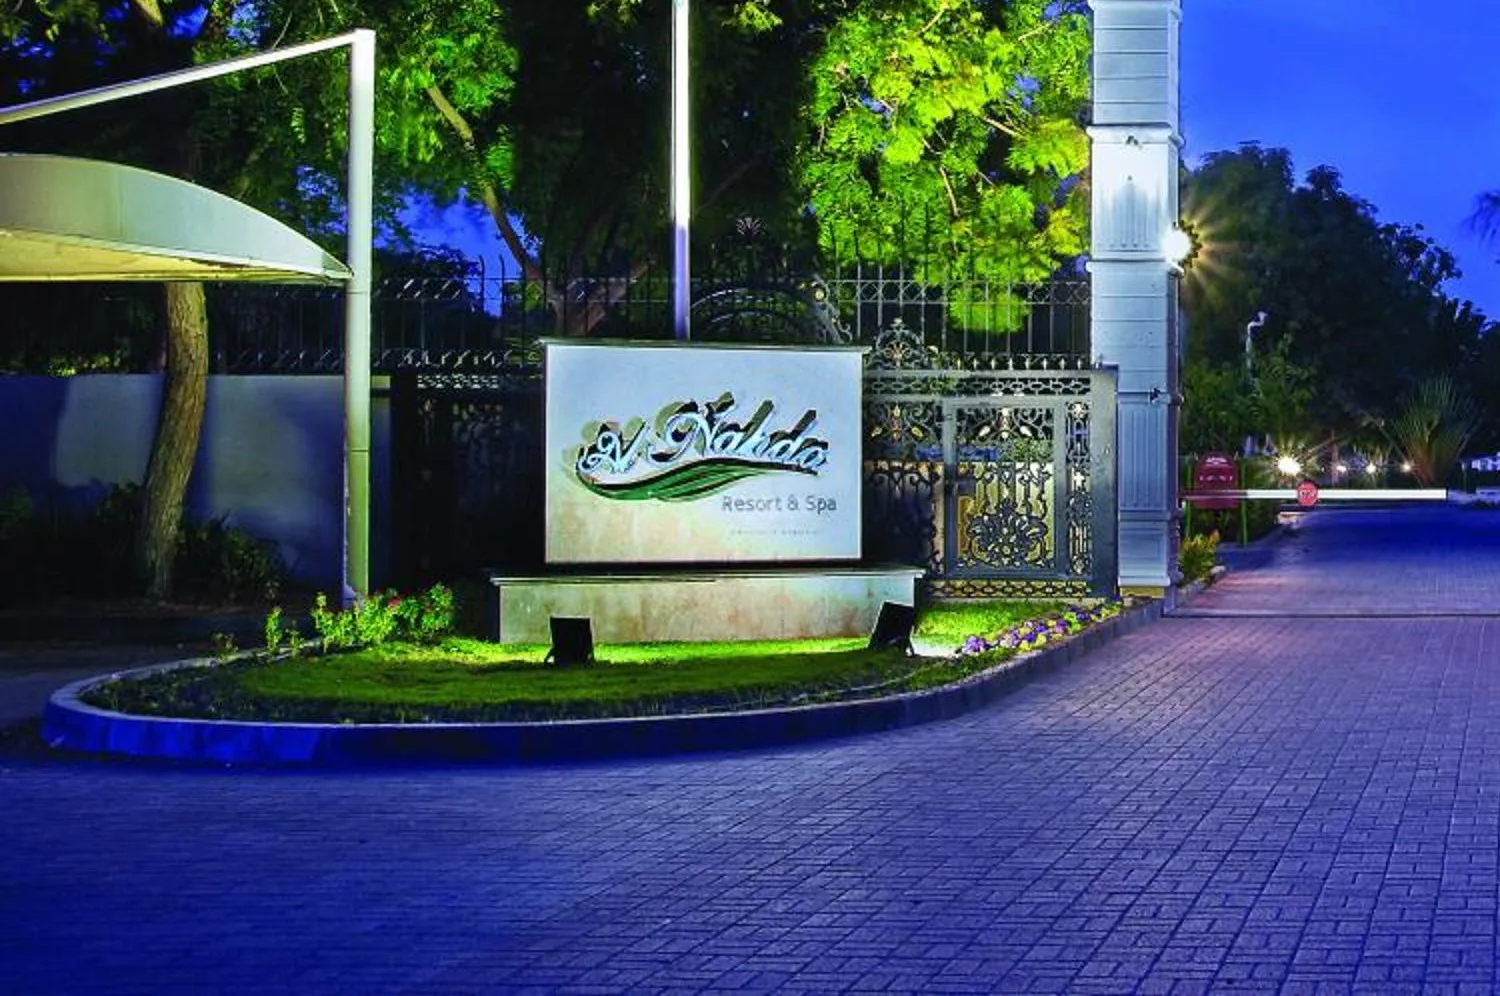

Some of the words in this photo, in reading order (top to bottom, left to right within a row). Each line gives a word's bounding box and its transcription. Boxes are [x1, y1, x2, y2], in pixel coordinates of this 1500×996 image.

[648, 391, 831, 470] Nahda
[722, 495, 783, 512] Resort
[787, 494, 801, 512] &
[805, 495, 838, 515] Spa
